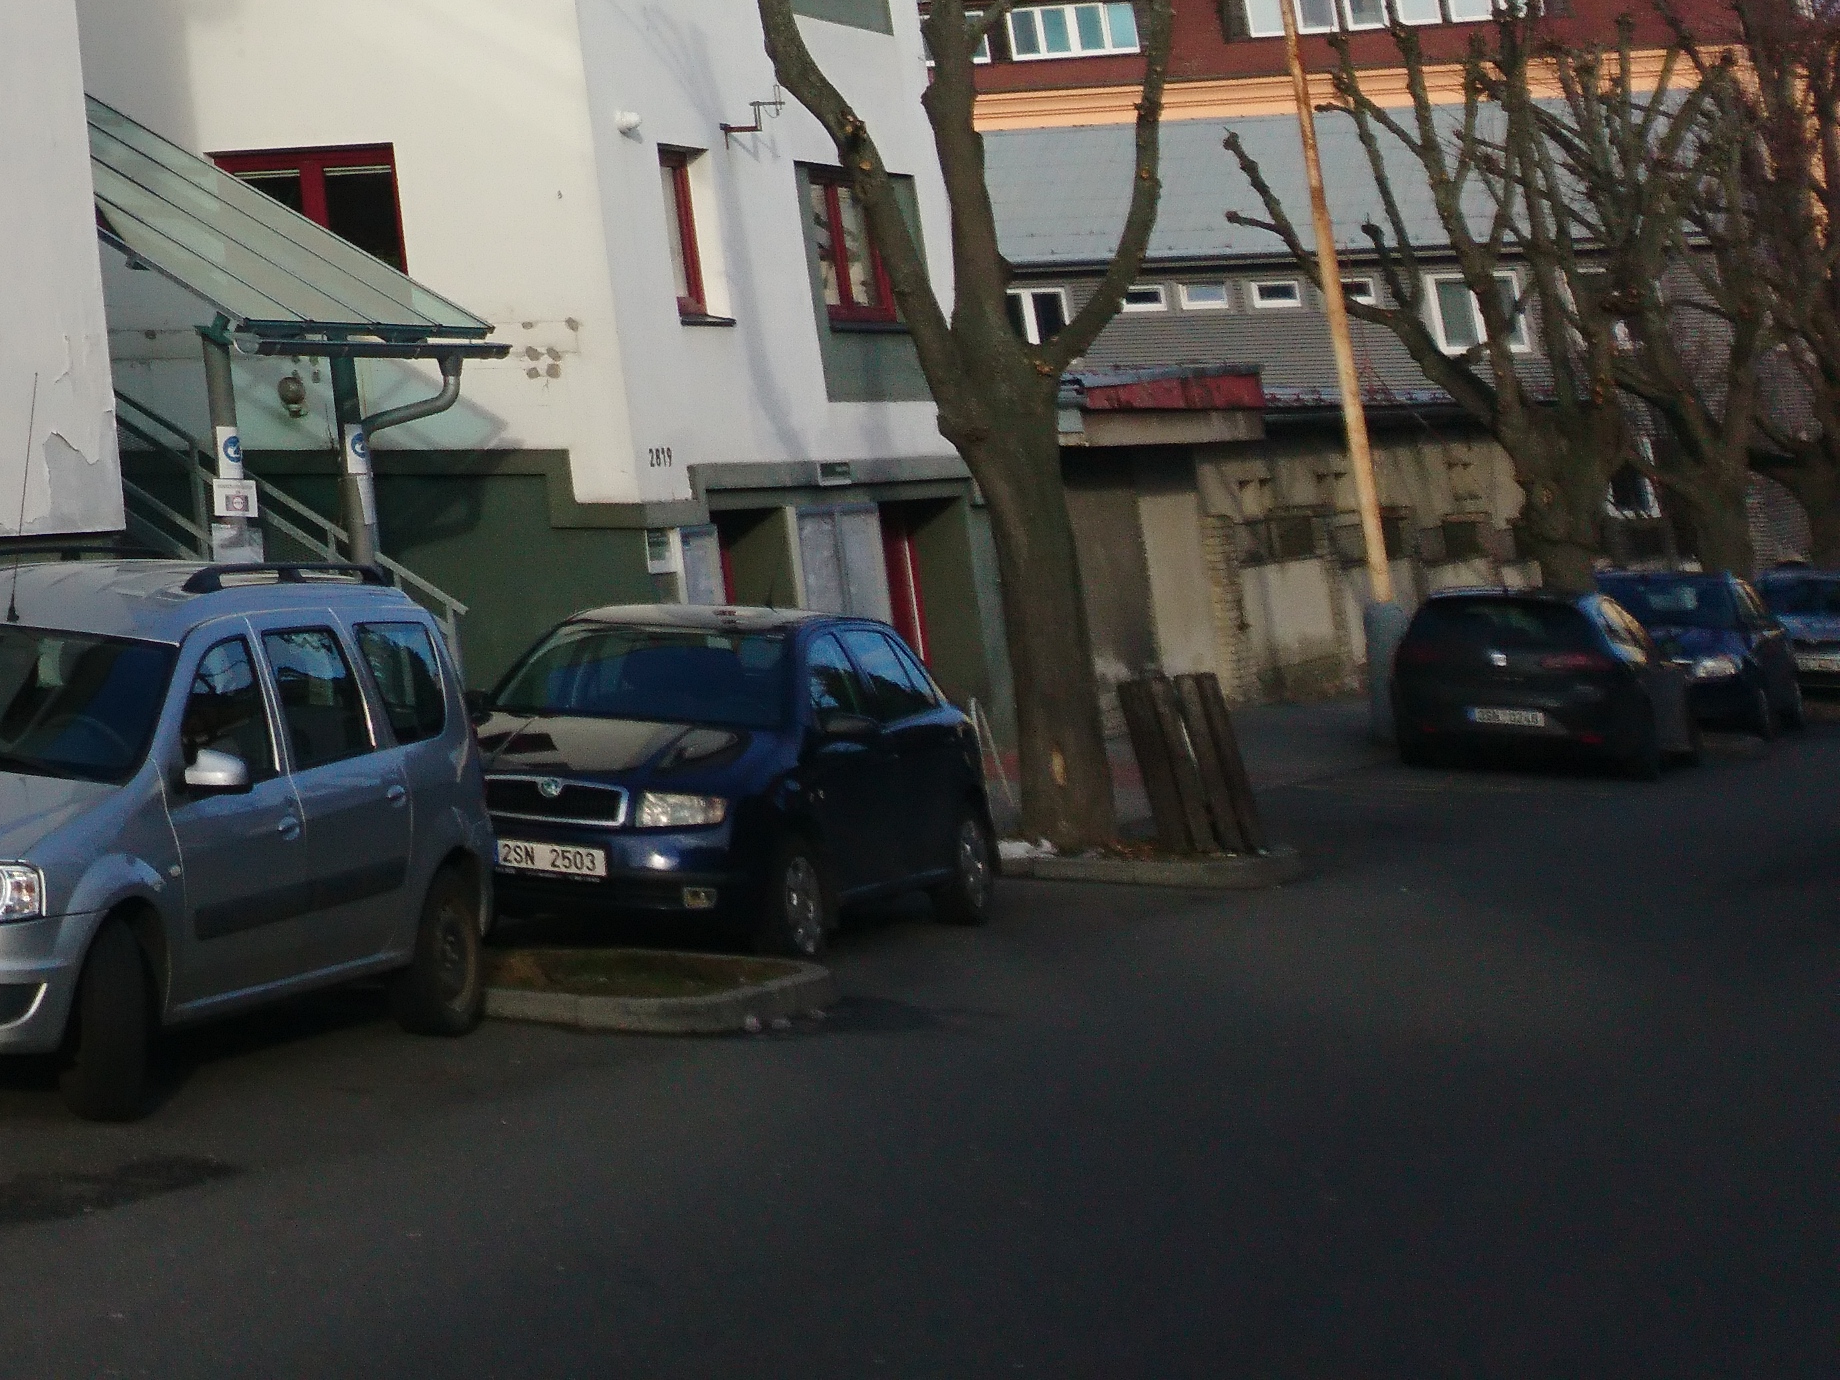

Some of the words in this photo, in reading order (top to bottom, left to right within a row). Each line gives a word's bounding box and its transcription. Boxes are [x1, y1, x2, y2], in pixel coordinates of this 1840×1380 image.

[648, 447, 672, 468] 2819
[502, 843, 536, 866] 2SN
[549, 848, 597, 872] 2503
